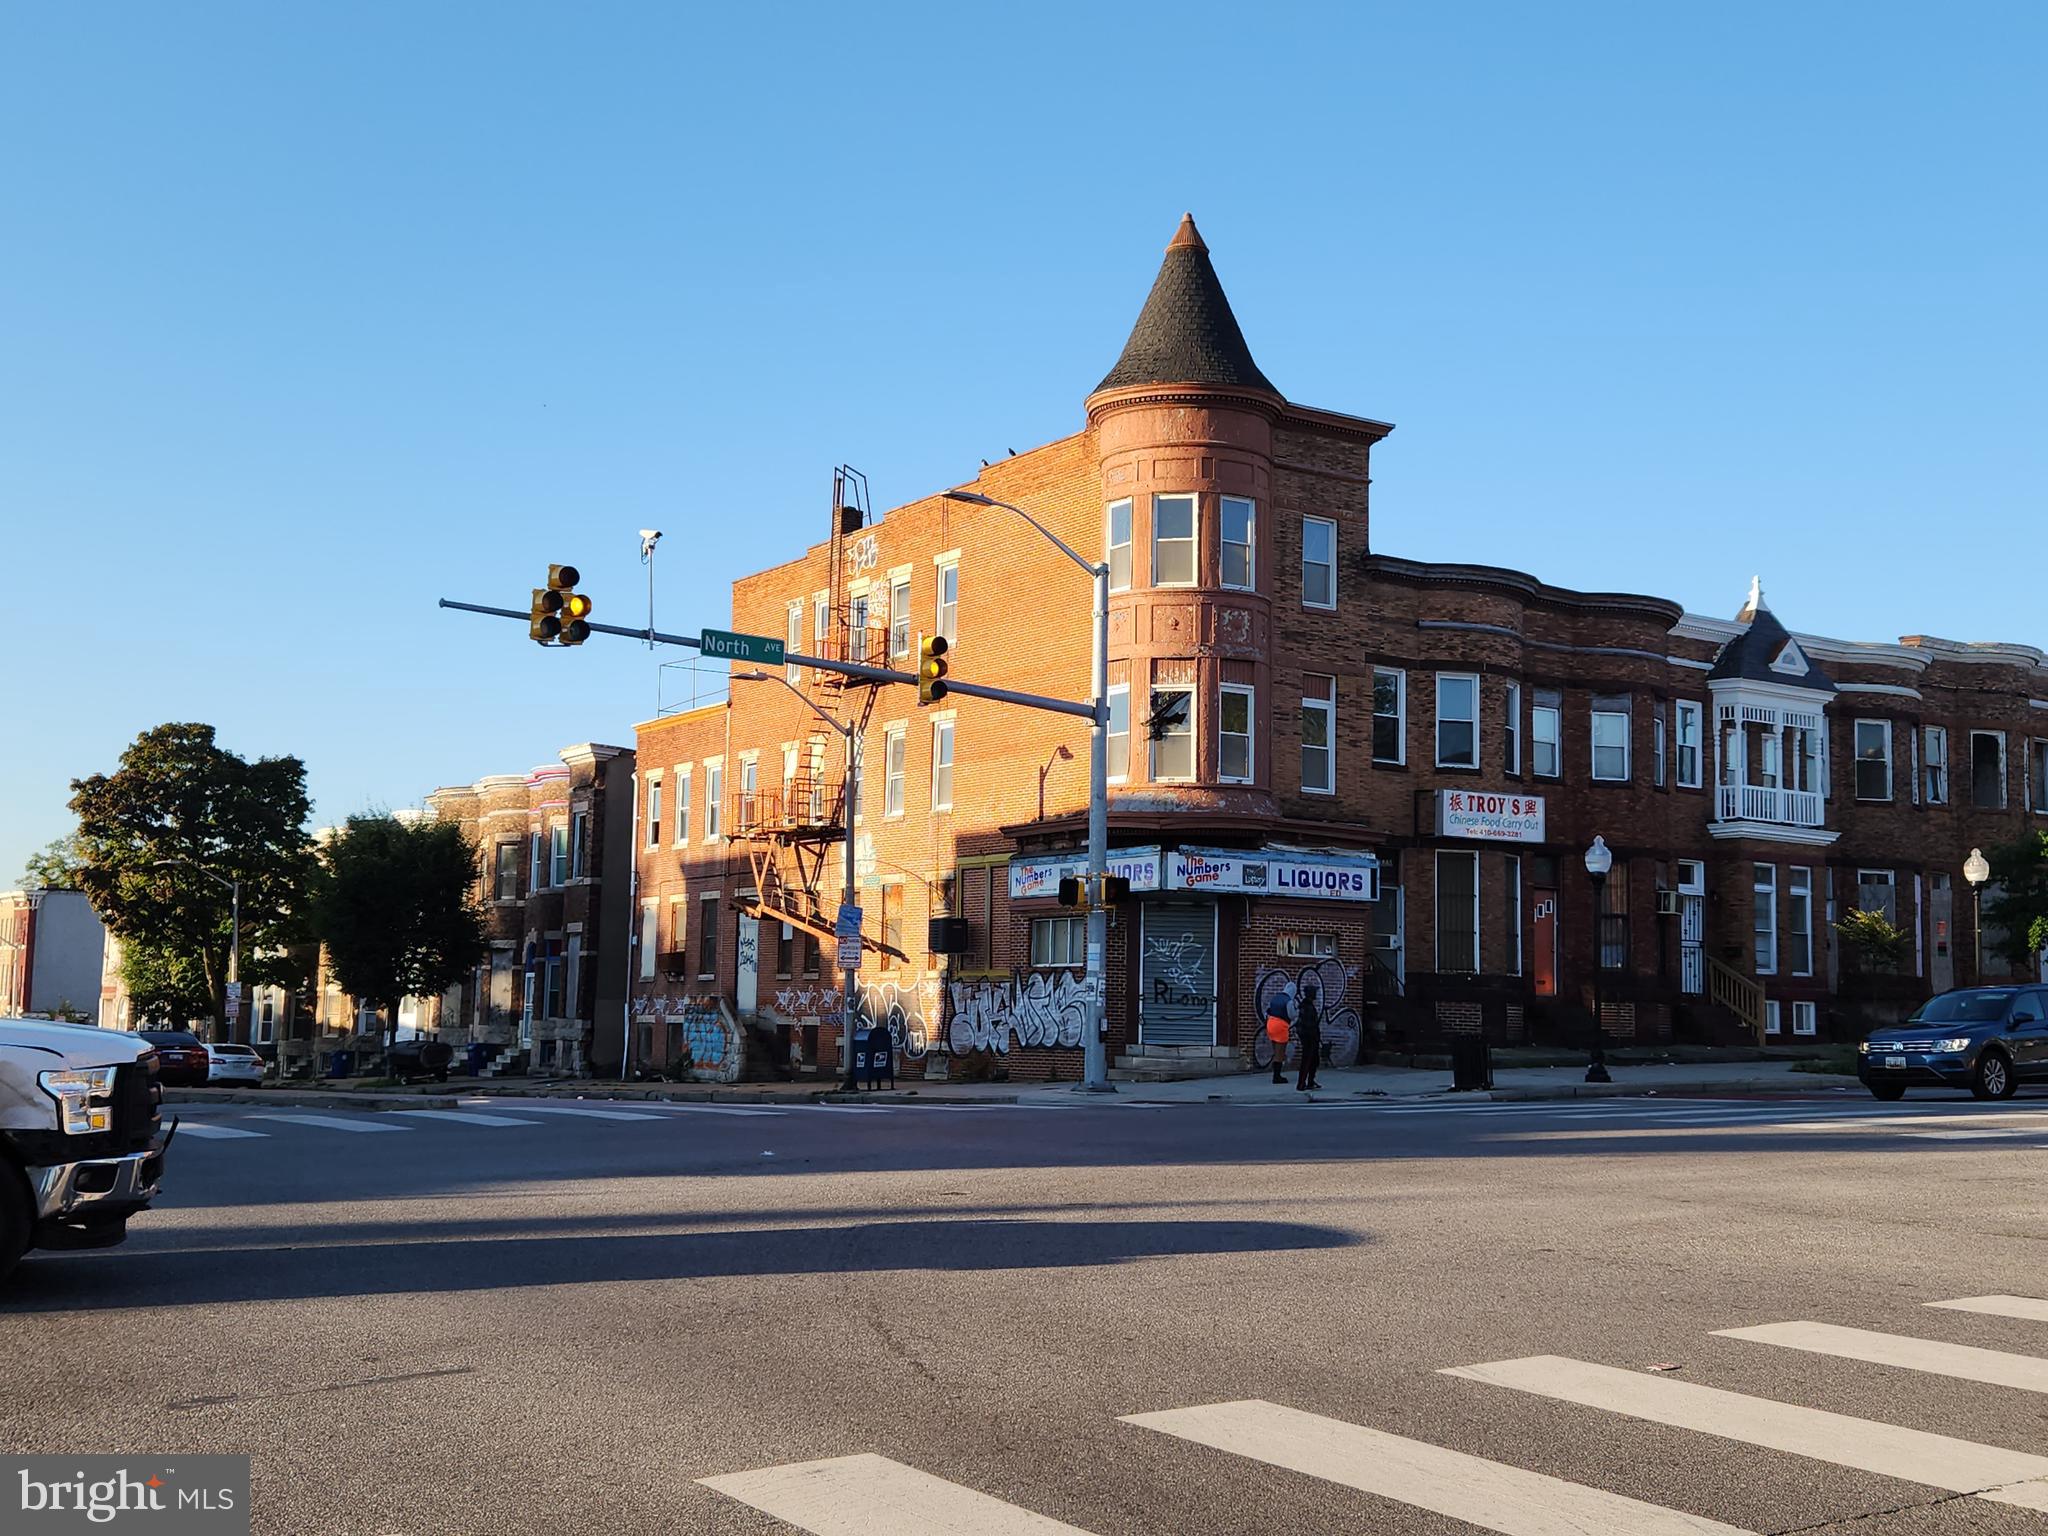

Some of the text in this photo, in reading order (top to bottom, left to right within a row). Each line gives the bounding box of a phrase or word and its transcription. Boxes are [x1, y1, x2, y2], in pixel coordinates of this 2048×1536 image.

[705, 635, 781, 656] North AVE
[1467, 795, 1520, 816] TROY'S
[1449, 814, 1538, 830] Chinese Food Carry Out
[1184, 853, 1204, 866] The
[1020, 865, 1034, 876] The
[1177, 862, 1231, 877] Numbers
[1015, 868, 1053, 888] Numbers
[1186, 873, 1219, 887] Game
[1278, 868, 1363, 891] LIQUORS
[1021, 879, 1044, 896] Game
